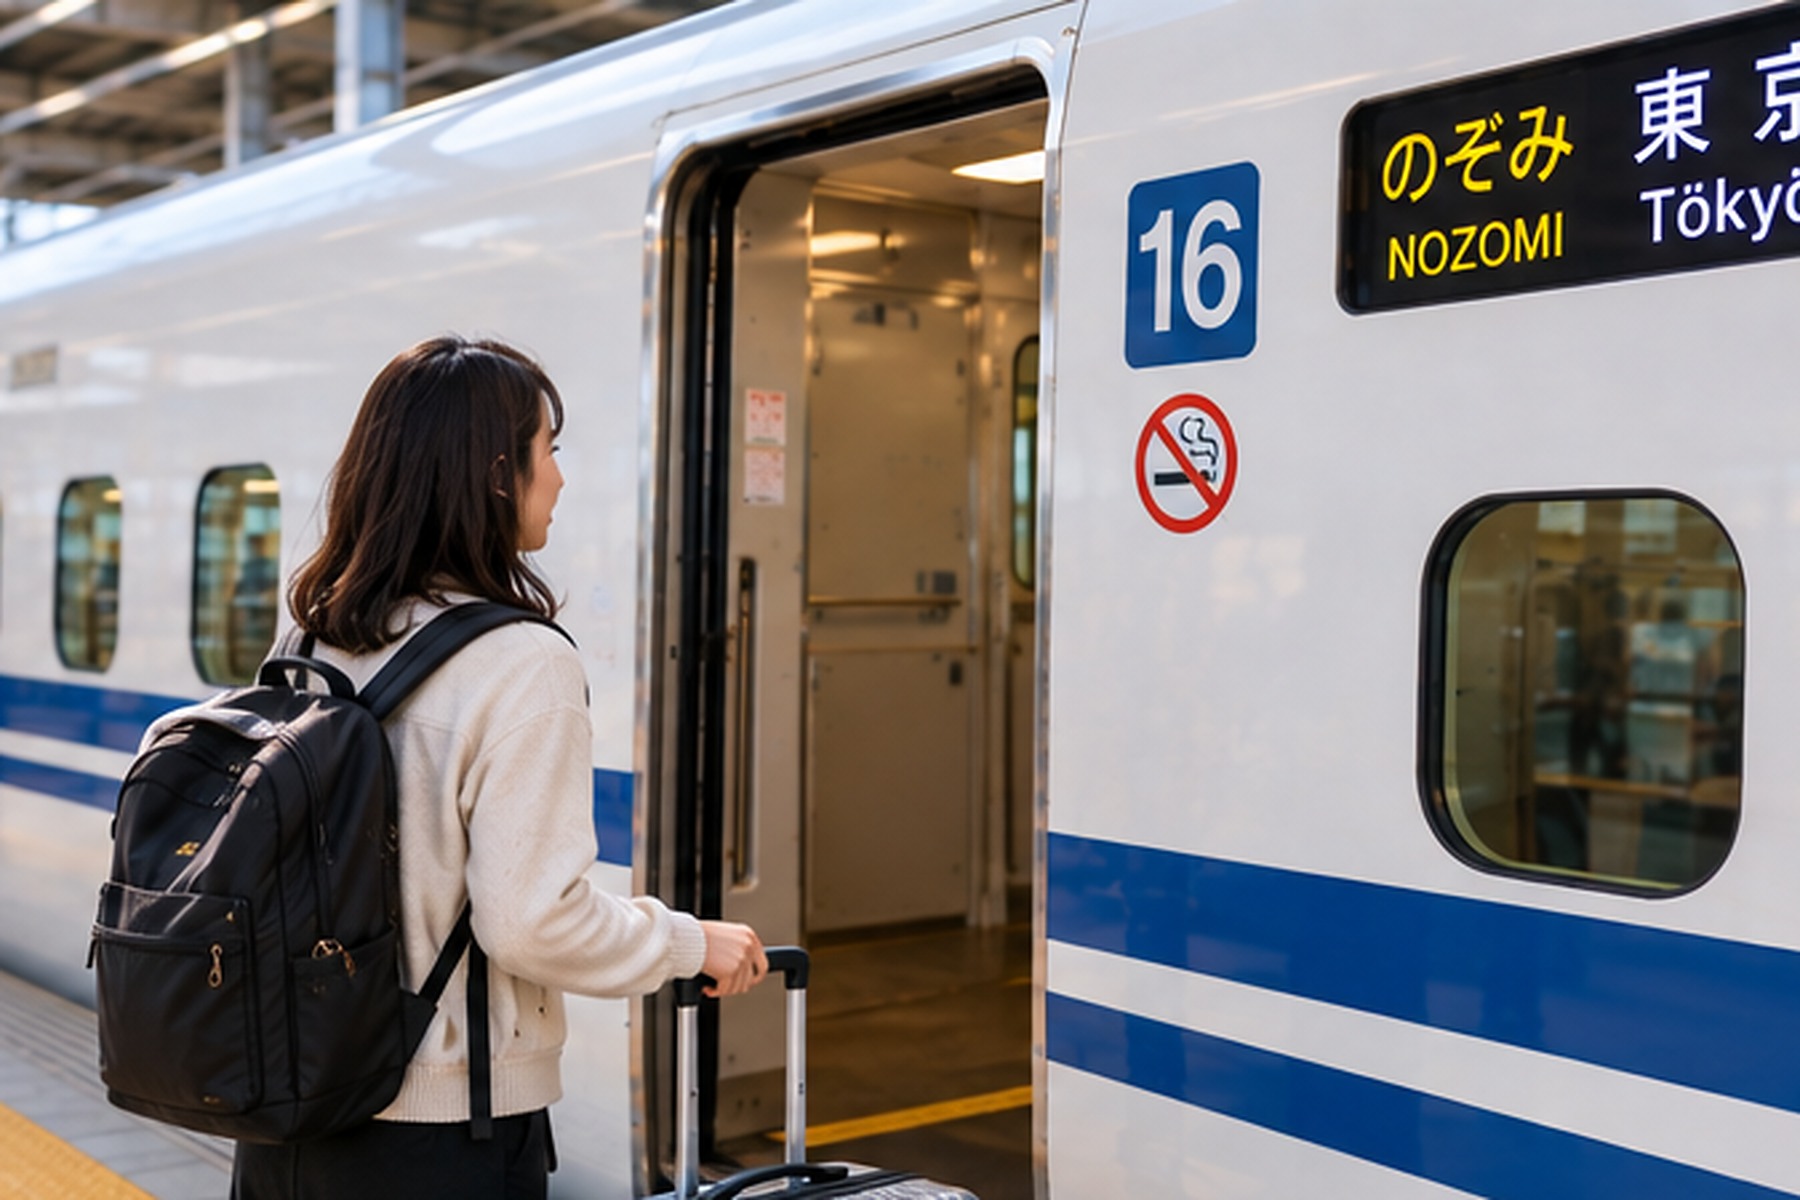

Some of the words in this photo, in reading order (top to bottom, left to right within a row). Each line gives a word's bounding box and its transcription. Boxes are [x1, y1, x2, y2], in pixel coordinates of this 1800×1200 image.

[1382, 105, 1574, 203] のぞみ
[1139, 199, 1242, 332] 16
[1388, 211, 1563, 281] NOZOMI
